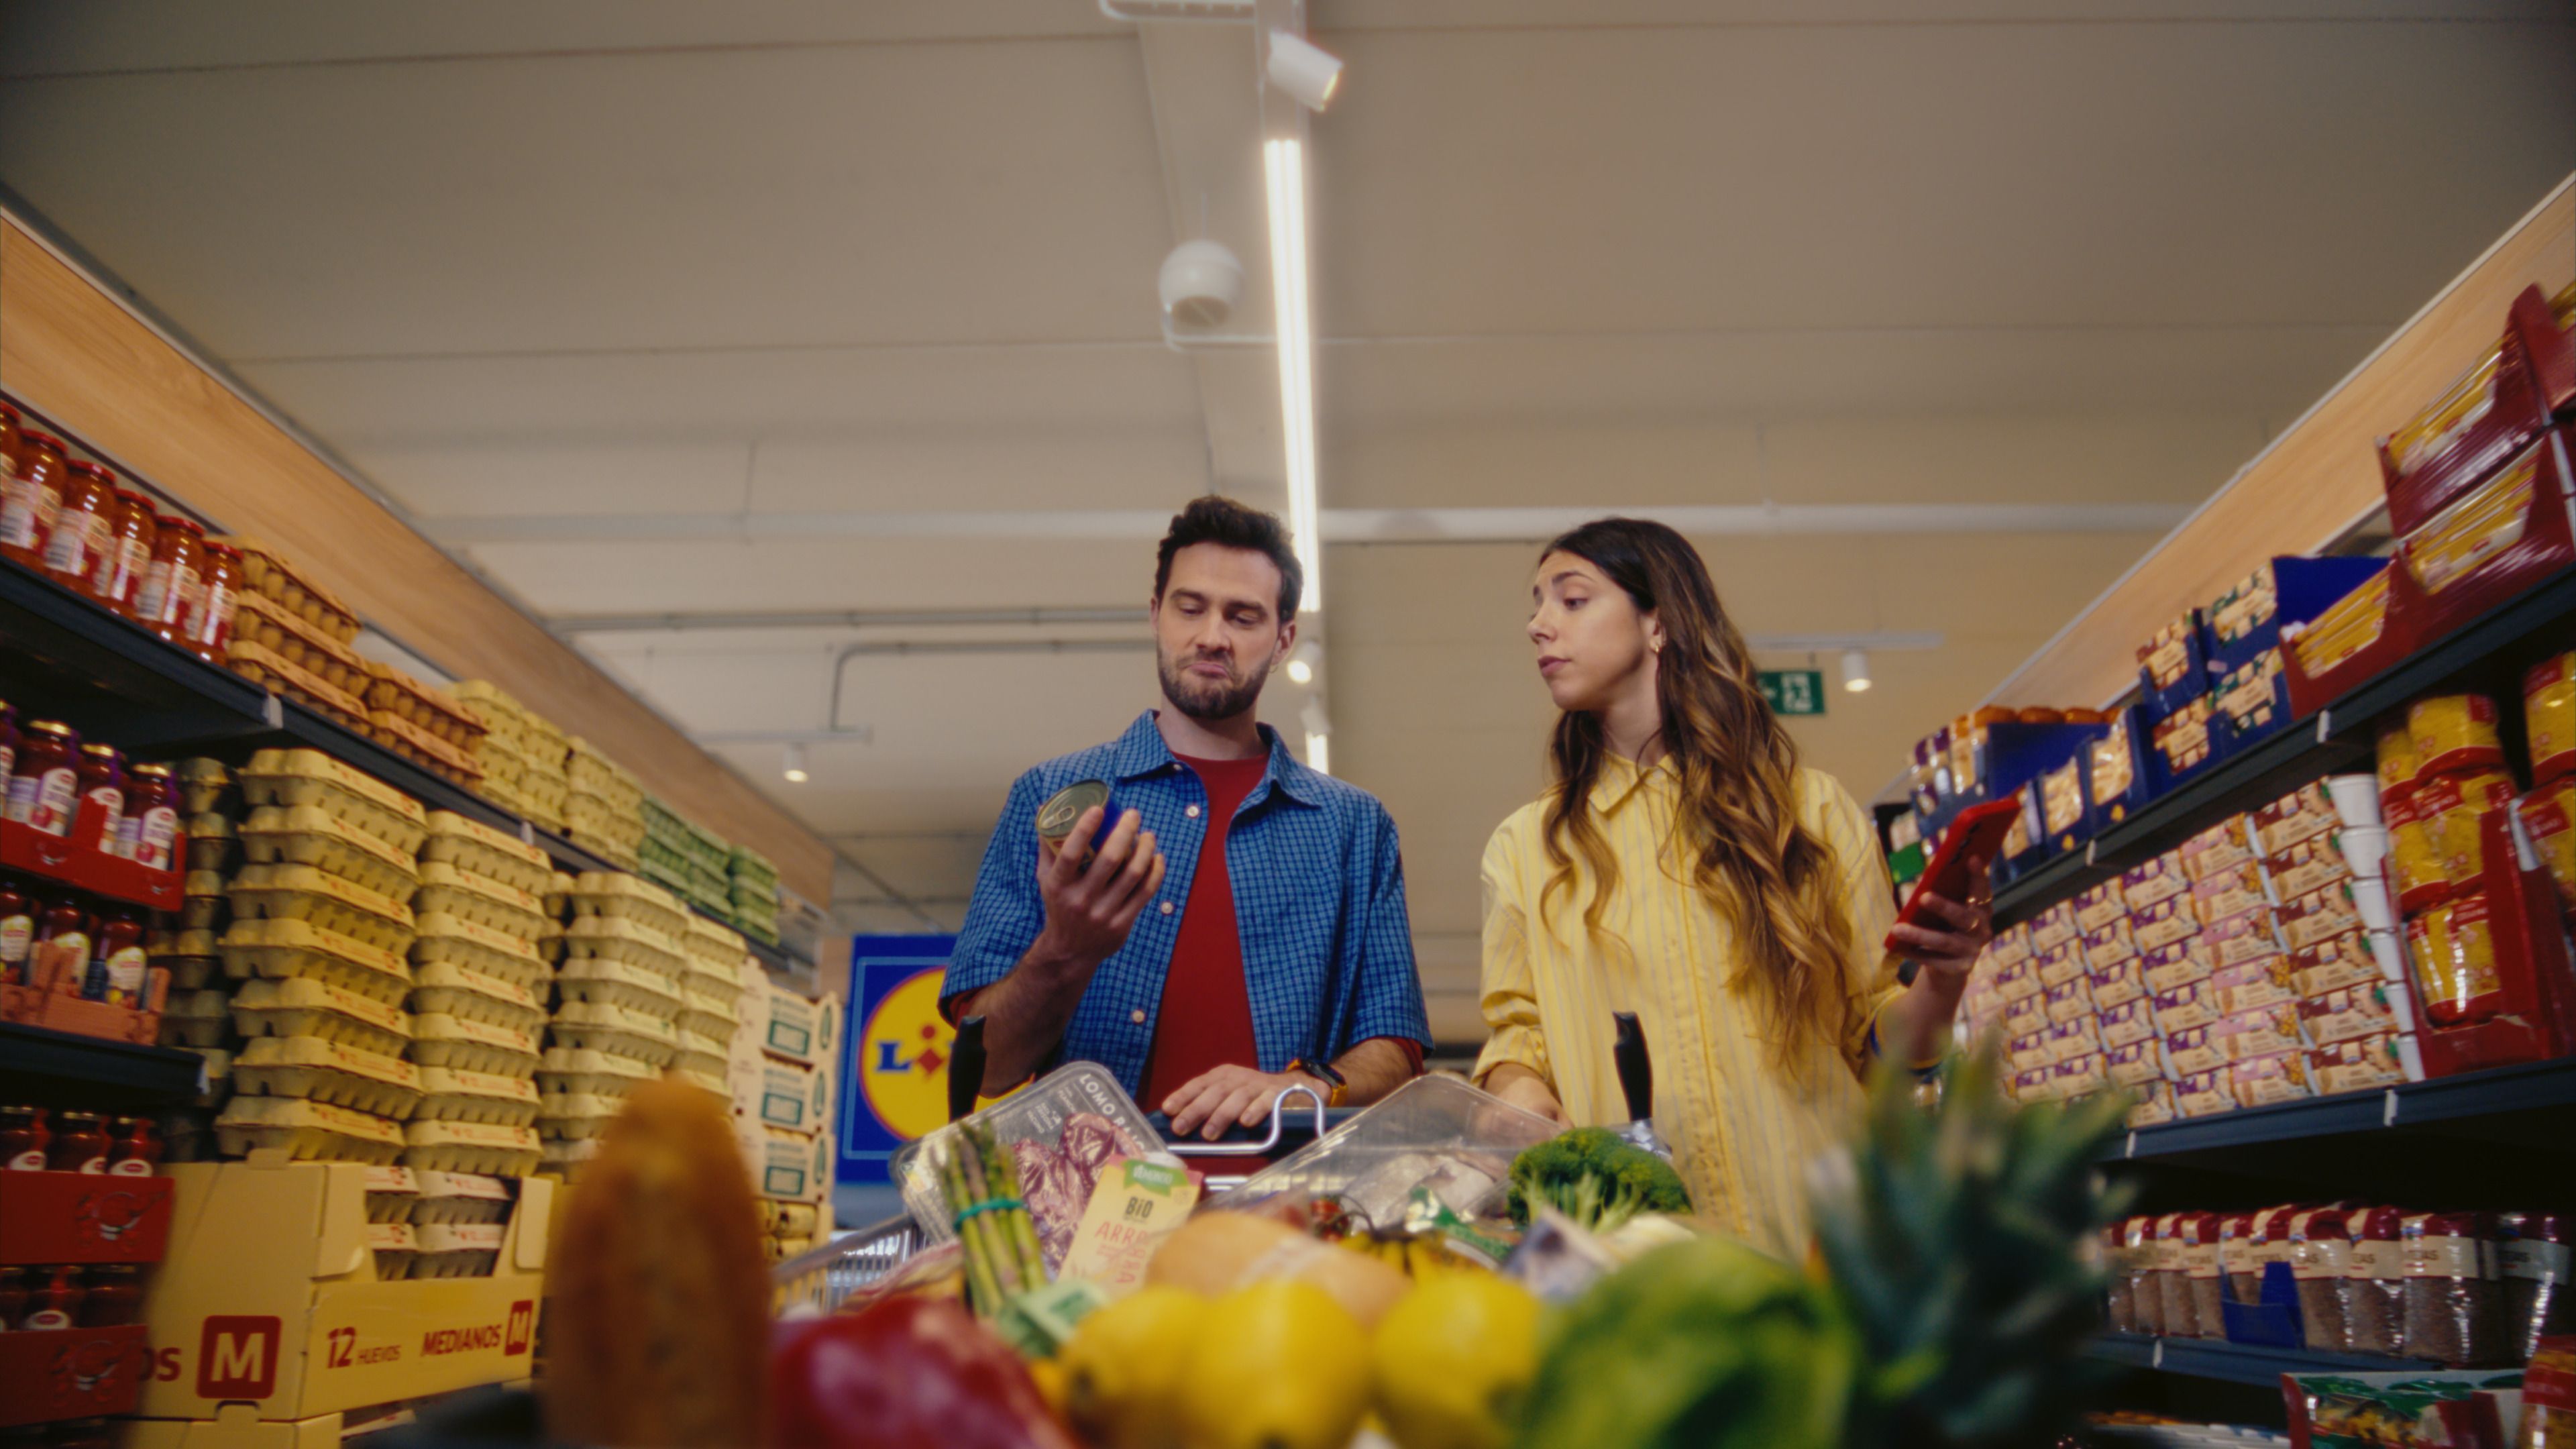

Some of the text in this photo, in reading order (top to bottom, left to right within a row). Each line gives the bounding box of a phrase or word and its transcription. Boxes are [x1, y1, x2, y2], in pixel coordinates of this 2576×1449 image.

[1079, 1073, 1116, 1115] LOMO
[327, 1326, 356, 1369] 12
[421, 1324, 502, 1356] MEDIANOS
